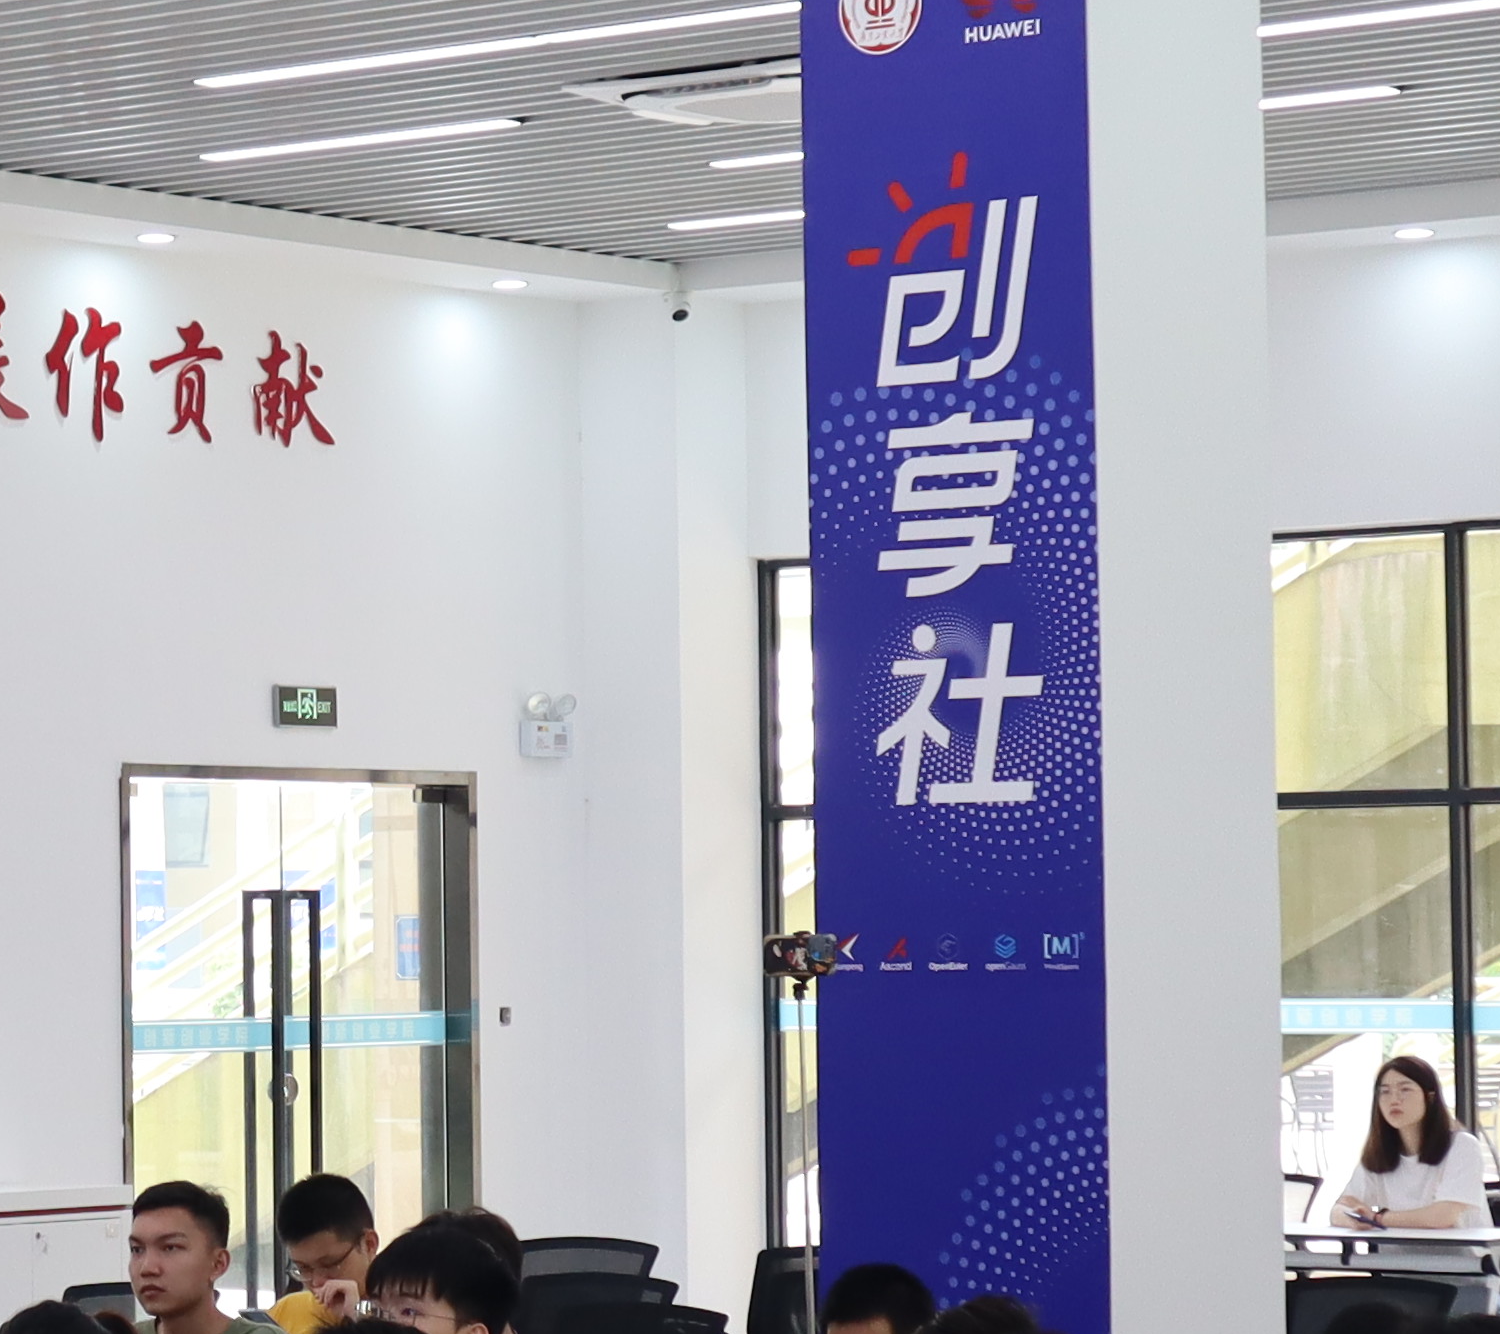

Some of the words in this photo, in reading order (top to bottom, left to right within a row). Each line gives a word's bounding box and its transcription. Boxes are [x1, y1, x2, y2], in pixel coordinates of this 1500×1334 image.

[964, 18, 1041, 44] HUAWEI
[868, 187, 1044, 806] 创享社
